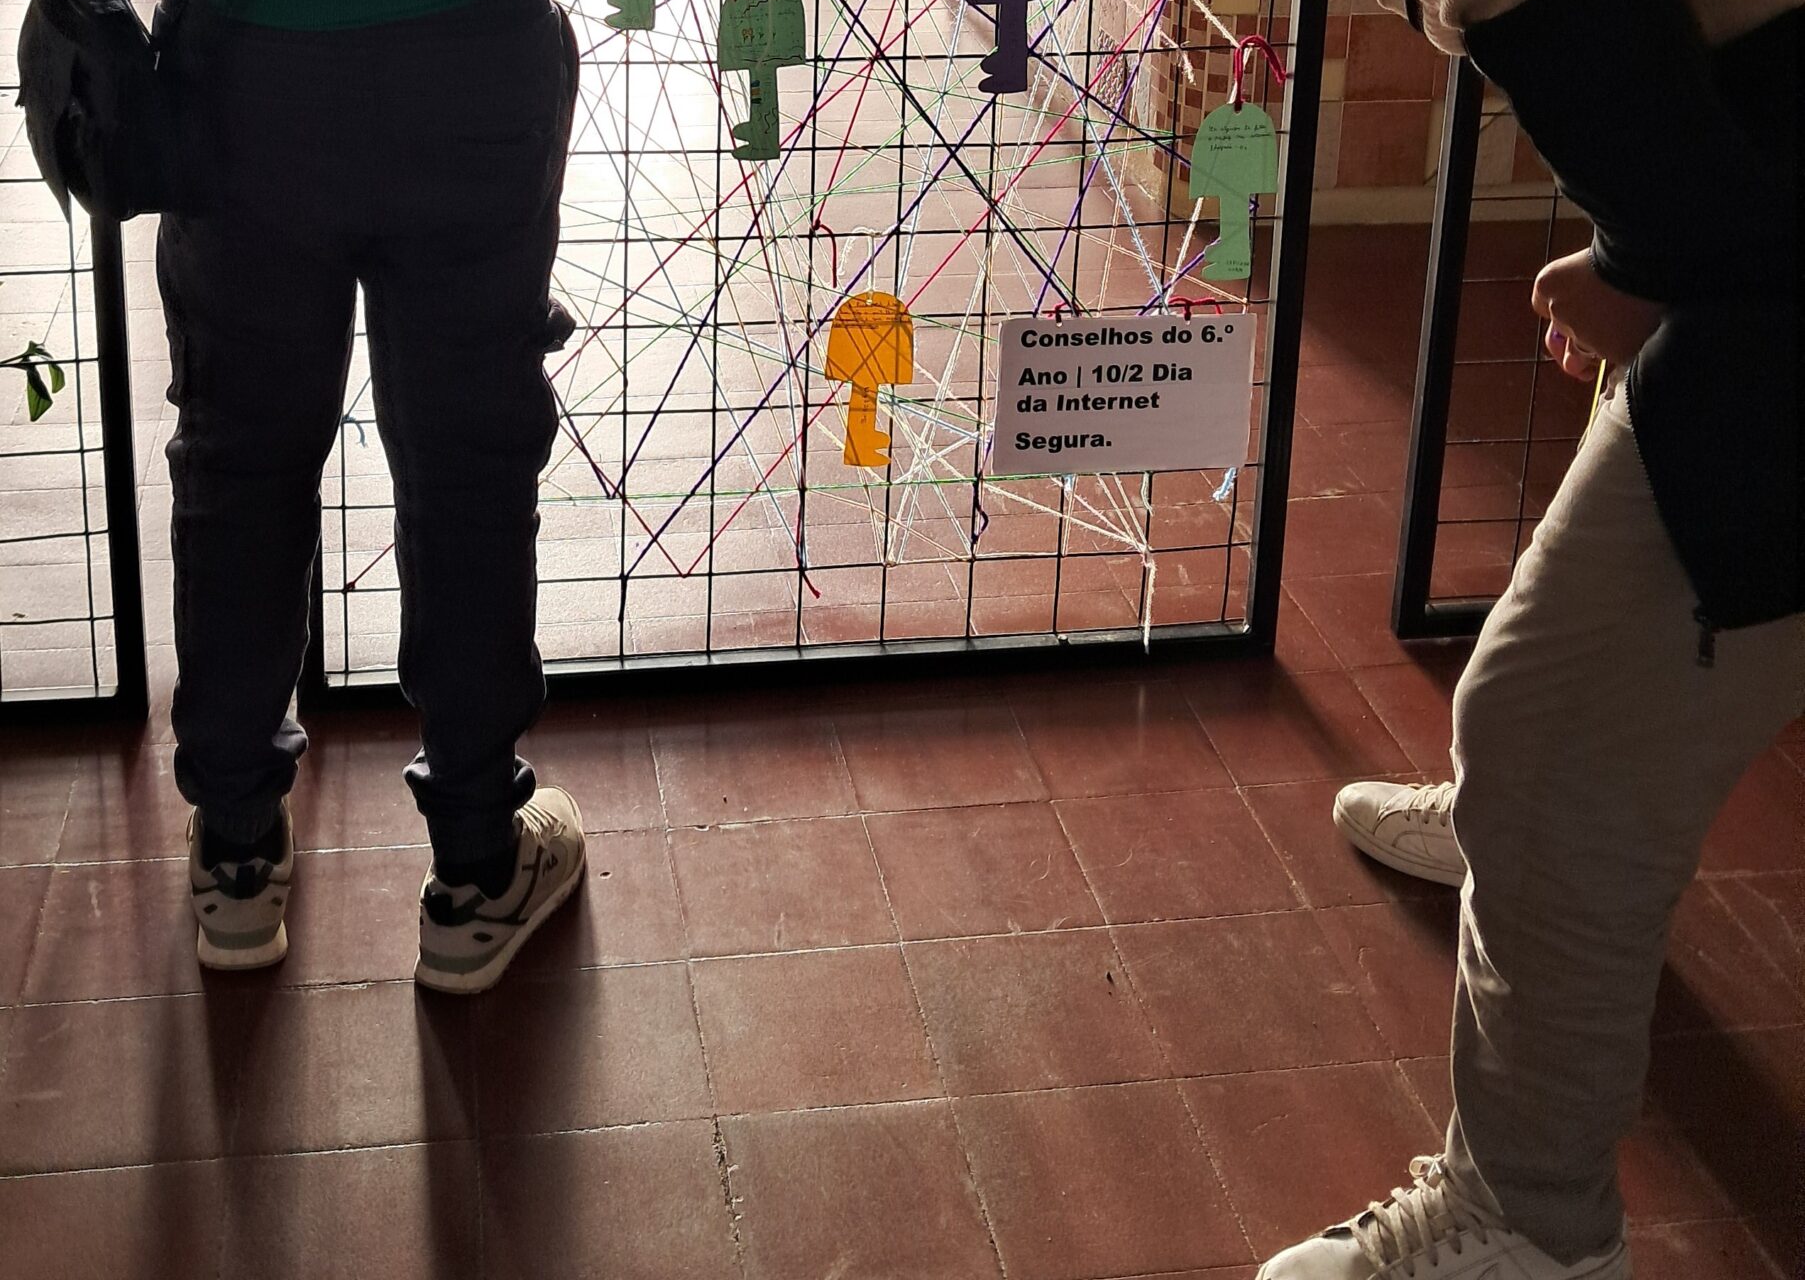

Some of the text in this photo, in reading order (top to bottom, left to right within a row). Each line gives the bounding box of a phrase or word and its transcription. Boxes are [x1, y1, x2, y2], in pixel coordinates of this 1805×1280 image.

[1020, 327, 1153, 348] Conselhos
[1161, 326, 1193, 344] do
[1018, 368, 1068, 386] Ano
[1091, 364, 1143, 384] 10/2
[1152, 363, 1193, 382] Dia
[1016, 391, 1161, 413] da Internet
[1014, 432, 1113, 453] Segura.
